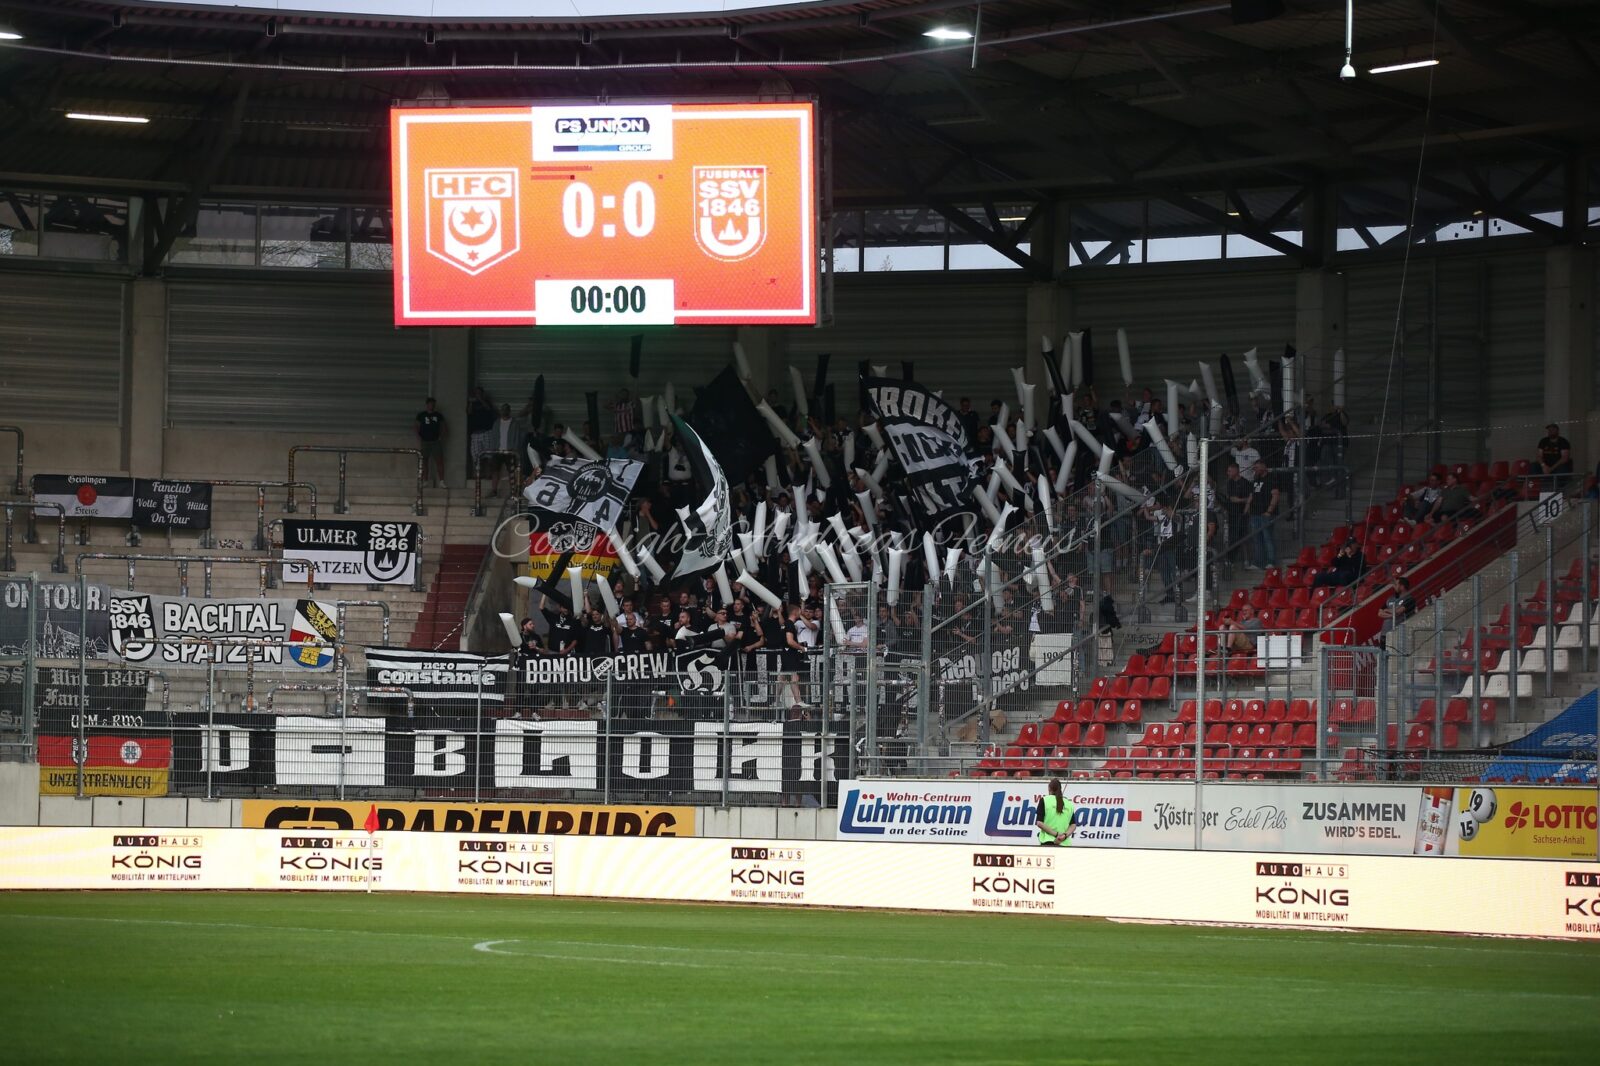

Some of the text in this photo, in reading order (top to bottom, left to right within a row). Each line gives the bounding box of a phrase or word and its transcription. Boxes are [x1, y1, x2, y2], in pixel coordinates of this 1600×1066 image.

[557, 118, 645, 133] PS UNION
[618, 144, 651, 152] GROUP
[436, 176, 506, 196] HFC
[699, 180, 760, 198] SSV
[562, 181, 656, 238] 0:0
[698, 199, 760, 216] 1846
[570, 286, 646, 313] 00:00
[152, 482, 192, 494] Fanclub
[136, 498, 158, 508] Volle
[186, 501, 209, 511] Hütte
[1543, 500, 1560, 518] 10
[151, 512, 190, 525] On Tour
[297, 528, 358, 546] ULMER
[370, 524, 412, 538] SSV
[368, 538, 408, 550] 1846
[532, 562, 548, 570] Ulm
[110, 597, 148, 614] SSV
[110, 614, 152, 628] 1846
[163, 602, 285, 632] BACHTAL
[423, 662, 455, 670] nero
[526, 656, 592, 684] DONAU
[614, 652, 668, 681] CREW
[102, 670, 146, 687] 1846
[886, 792, 972, 802] Wohn-Centrum
[1470, 790, 1483, 812] 19
[840, 789, 972, 834] Lührmann
[1224, 806, 1260, 830] Edel
[1255, 805, 1288, 830] Pils
[1302, 802, 1406, 821] ZUSAMMEN
[1534, 805, 1598, 830] LOTTO
[908, 826, 926, 835] der
[929, 827, 968, 836] Saline
[1080, 831, 1120, 840] Saline
[1368, 826, 1401, 838] EDEL.
[1460, 820, 1474, 836] 15
[116, 837, 199, 846] AUTOHAUS
[284, 840, 378, 848] AUTOHAUS
[1533, 834, 1585, 844] Sachsen-Anhalt
[462, 842, 549, 852] AUTOHAUS
[734, 849, 802, 860] AUTOHAUS
[112, 850, 202, 868] KÖNIG
[280, 852, 382, 870] KÖNIG
[459, 856, 552, 874] KÖNIG
[976, 856, 1052, 867] AUTOHAUS
[731, 864, 804, 886] KÖNIG
[1260, 864, 1344, 876] AUTOHAUS
[972, 872, 1055, 894] KÖNIG
[731, 889, 758, 898] MOBILITÄT
[768, 891, 804, 900] MITTELPUNKT
[1256, 882, 1349, 906] KÖNIG
[972, 898, 1003, 907] MOBILITÄT
[1014, 900, 1055, 910] MITTELPUNKT
[1256, 910, 1349, 922] MOBILITÄT IM MITTELPUNKT
